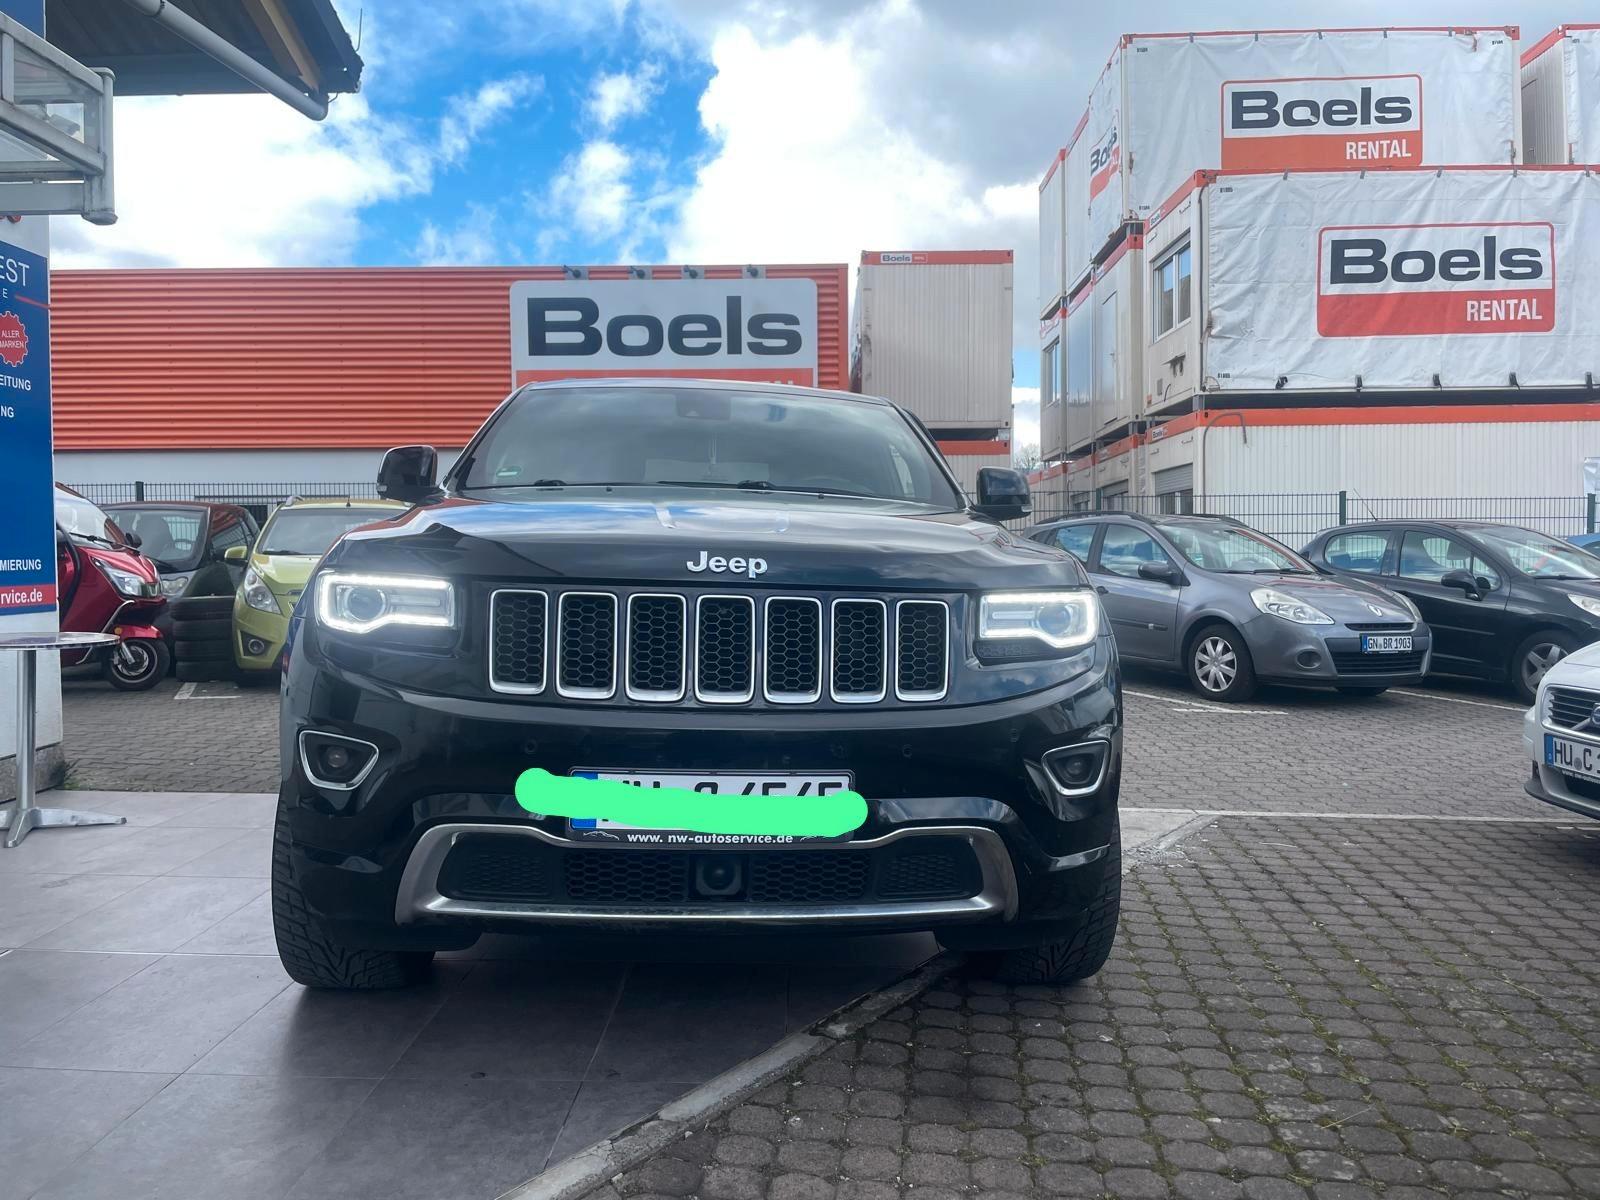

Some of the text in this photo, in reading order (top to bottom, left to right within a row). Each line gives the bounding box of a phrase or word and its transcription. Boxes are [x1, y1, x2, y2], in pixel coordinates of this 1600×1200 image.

[1231, 87, 1412, 129] Boels
[1345, 139, 1412, 160] RENTAL
[1330, 235, 1543, 284] Boels
[1466, 298, 1543, 322] RENTAL
[1, 329, 20, 338] ALLER
[527, 295, 803, 357] Boels
[0, 340, 24, 349] MARKEN
[0, 374, 31, 391] EITUNG
[0, 559, 42, 571] MIERUNG
[686, 551, 768, 579] Jeep
[0, 588, 43, 605] rvice.de
[1367, 637, 1411, 650] GN BR 1903
[1554, 740, 1573, 767] HU
[1583, 748, 1593, 771] C
